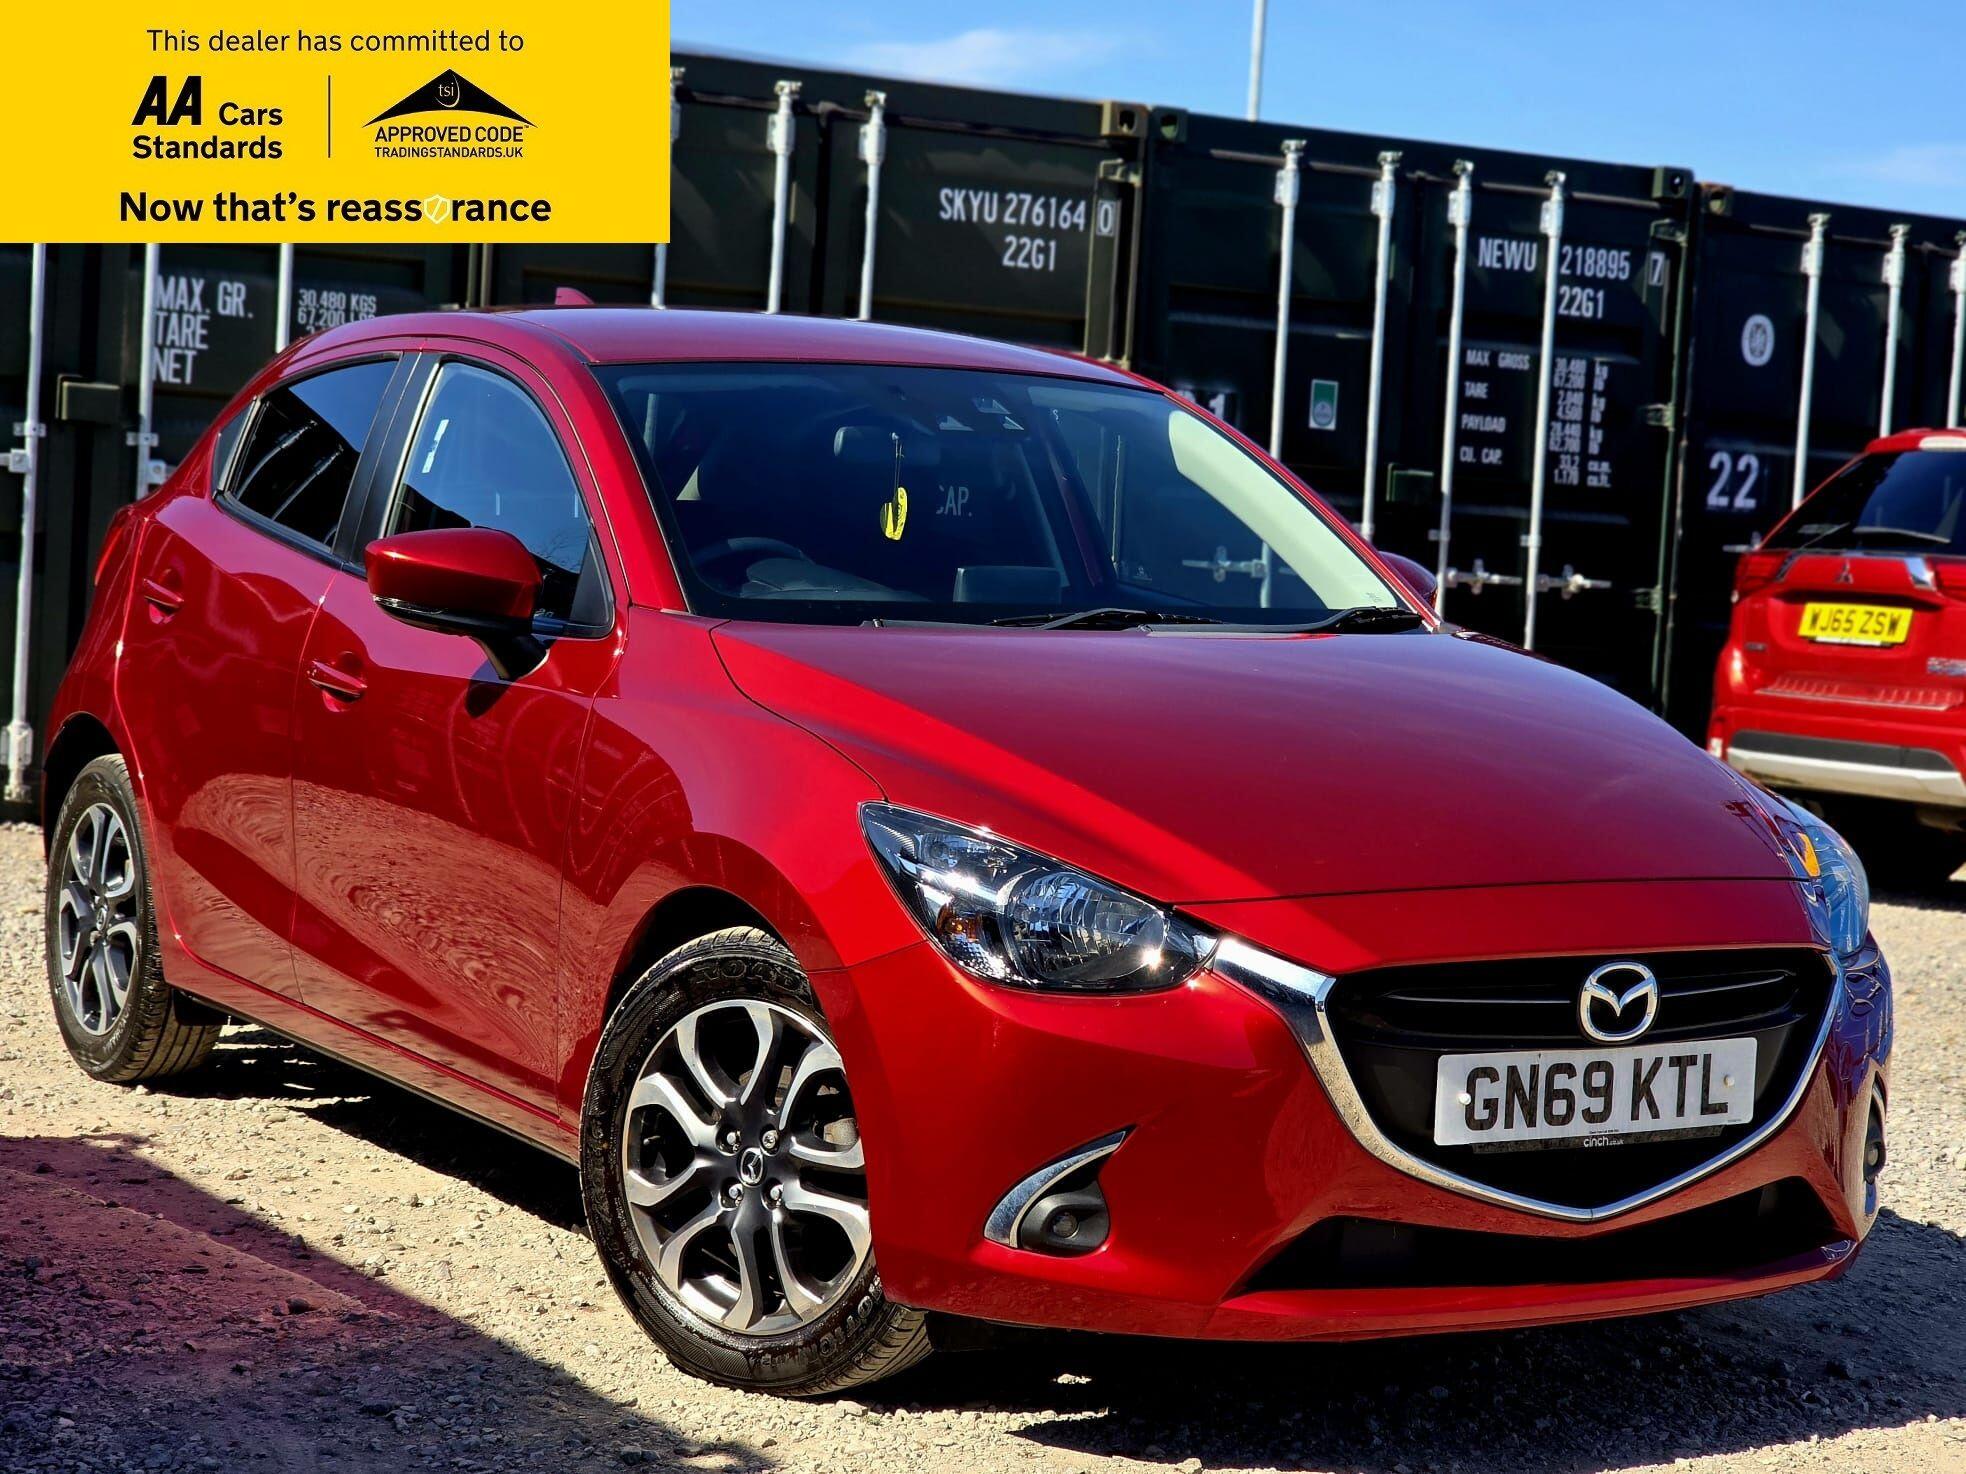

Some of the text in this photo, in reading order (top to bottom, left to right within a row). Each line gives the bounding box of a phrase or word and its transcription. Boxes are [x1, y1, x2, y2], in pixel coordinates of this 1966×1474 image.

[938, 187, 998, 223] SKYU
[1003, 193, 1087, 232] 276164
[1002, 235, 1056, 271] 22G1
[1478, 237, 1665, 286] NEWU 218895 7
[153, 274, 254, 319] MAX. GR.
[298, 289, 377, 314] 30.480 KGS
[1558, 285, 1605, 319] 22G1
[153, 311, 211, 350] TARE
[152, 347, 198, 385] NET
[1465, 349, 1491, 367] MAX
[1497, 352, 1531, 371] GROSS
[1464, 381, 1489, 399] TARE
[1461, 413, 1507, 432] PAYLOAD
[1706, 451, 1760, 509] 22
[1808, 609, 1902, 637] WJ65 ZSW
[1464, 1053, 1729, 1132] GN69 KTL
